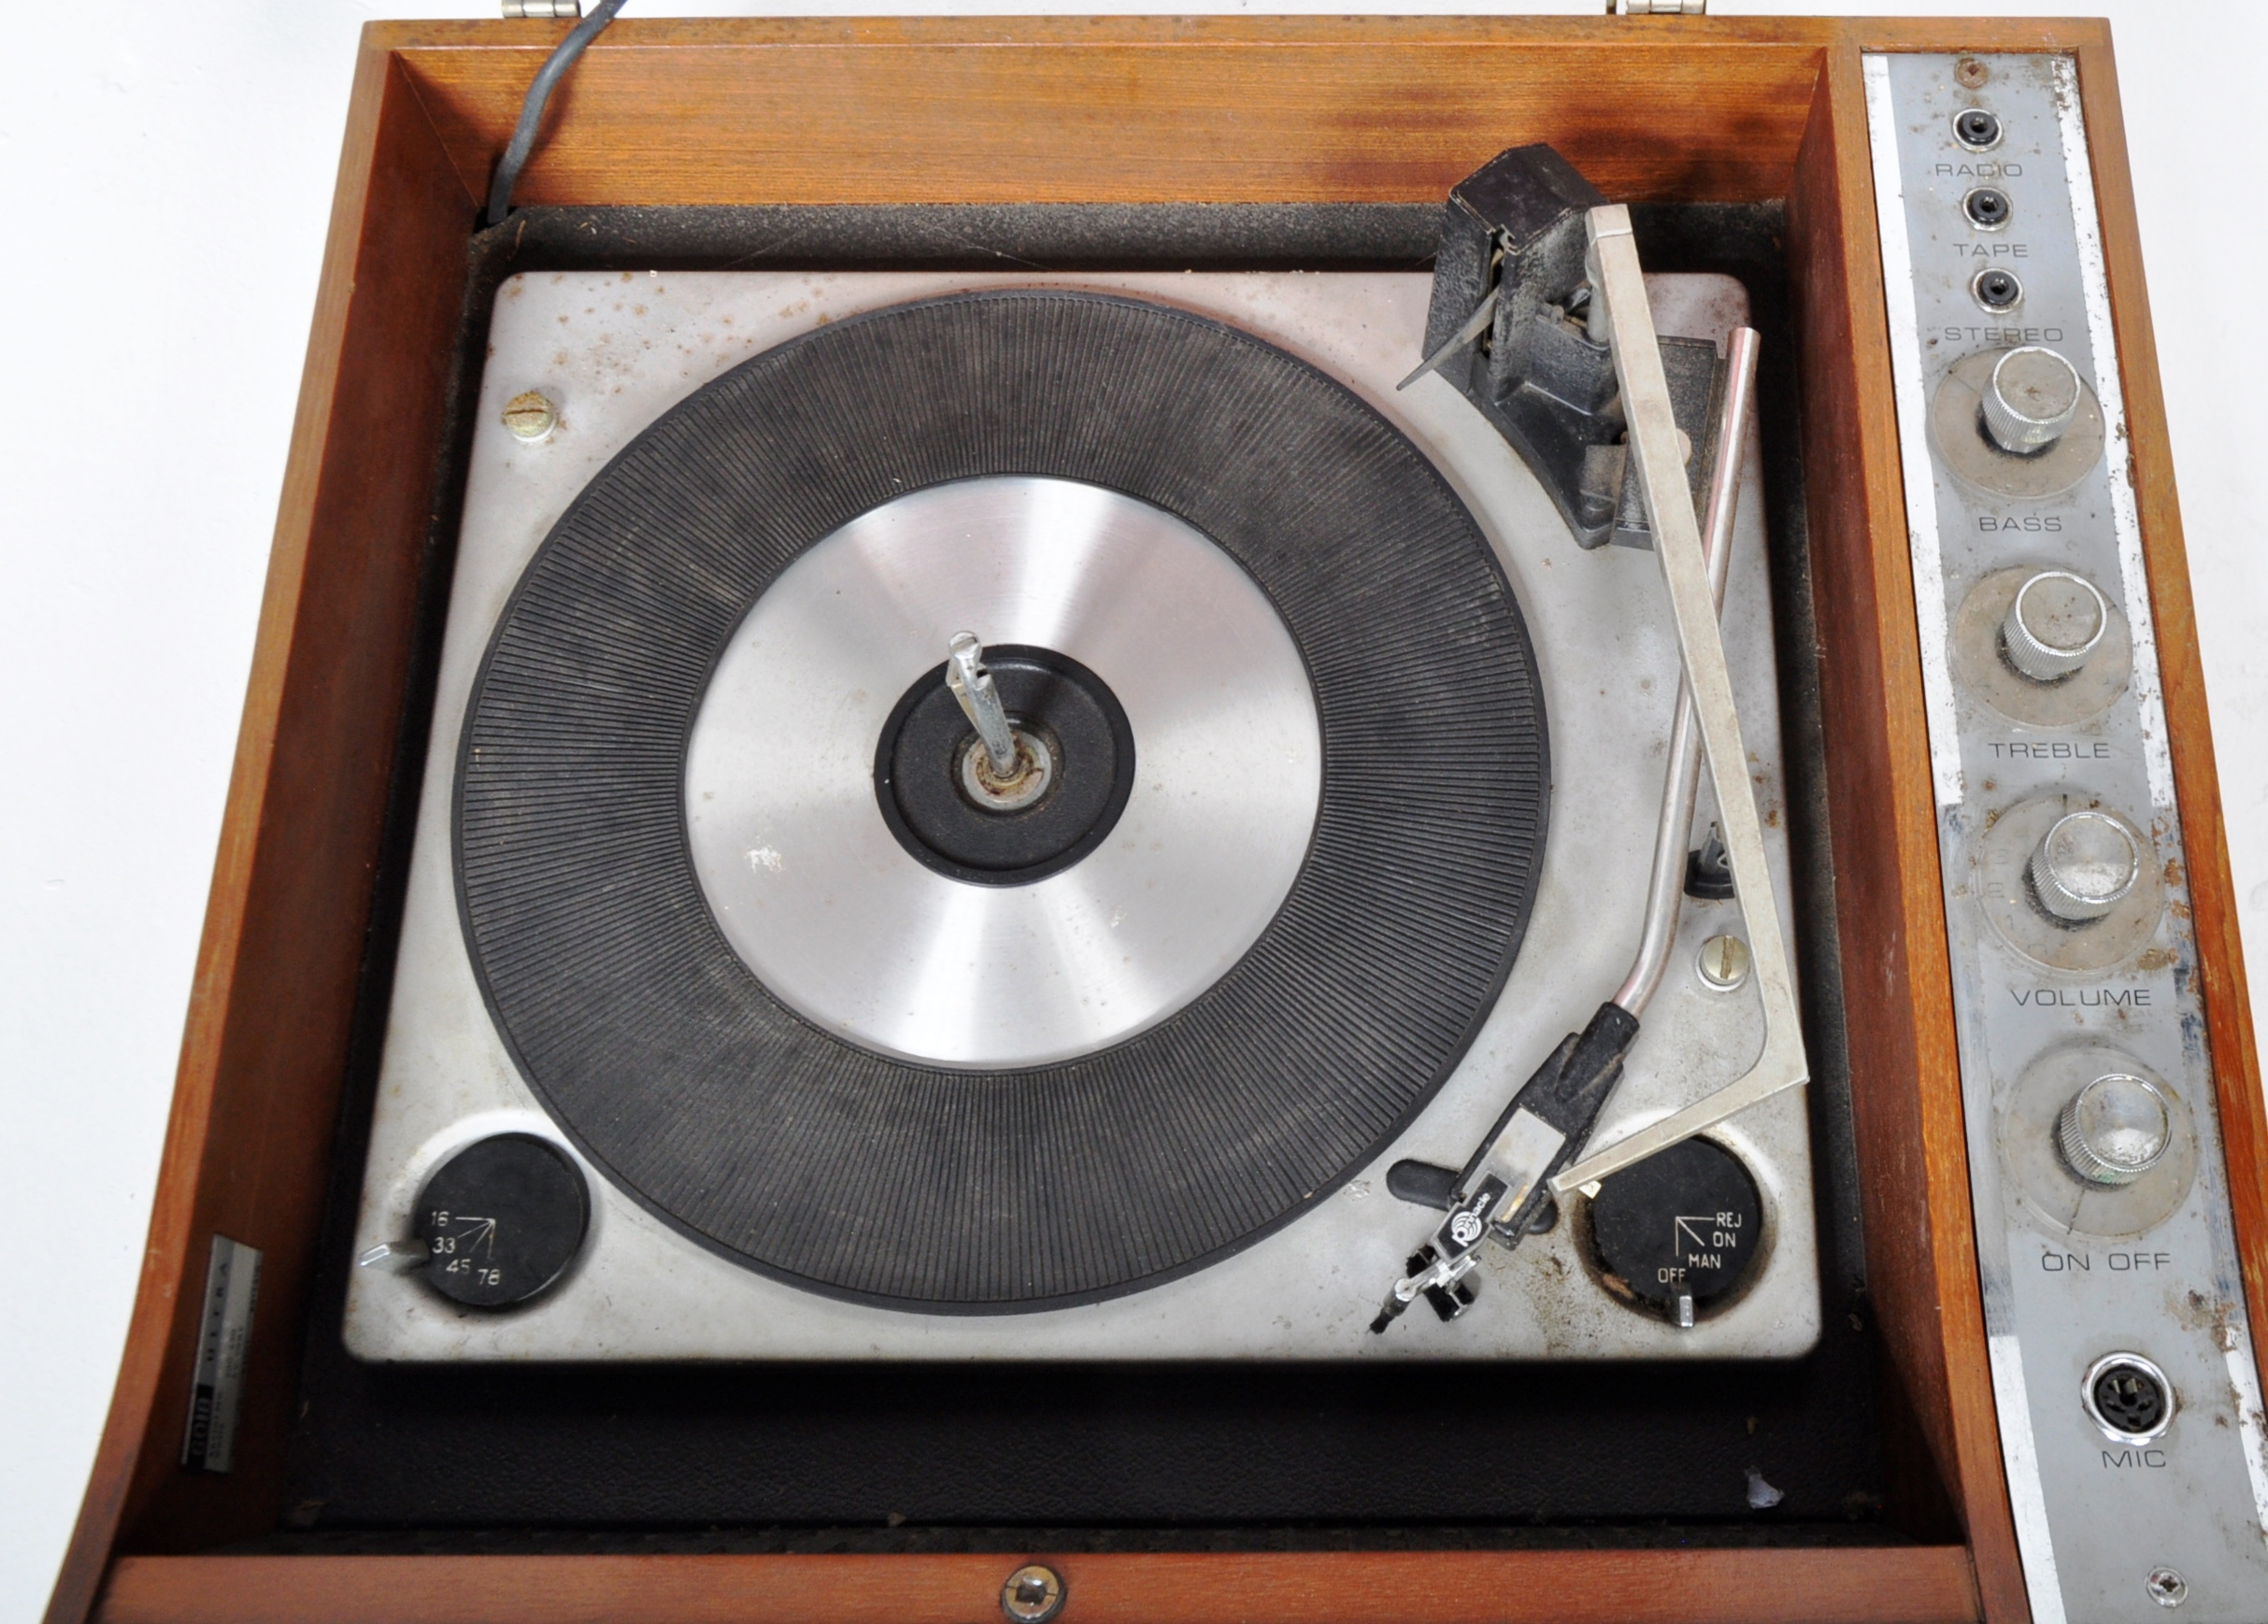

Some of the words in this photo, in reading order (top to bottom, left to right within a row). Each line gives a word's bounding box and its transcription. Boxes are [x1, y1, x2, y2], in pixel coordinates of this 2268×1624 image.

[1935, 164, 2023, 178] RADIO
[1952, 243, 2029, 258] TAPE
[1945, 327, 2063, 342] STEREO
[1978, 516, 2062, 533] BASS
[1988, 742, 2111, 759] TREBLE
[2010, 989, 2152, 1007] VOLUME
[431, 1210, 449, 1227] 16
[1716, 1212, 1742, 1228] REJ
[432, 1236, 456, 1254] 33
[1713, 1231, 1736, 1248] ON
[446, 1259, 471, 1275] 45
[1688, 1253, 1721, 1269] MAN
[2041, 1252, 2090, 1272] ON
[2107, 1252, 2171, 1271] OFF
[478, 1268, 502, 1286] 78
[1658, 1267, 1687, 1284] OFF
[2102, 1450, 2166, 1469] MIC
